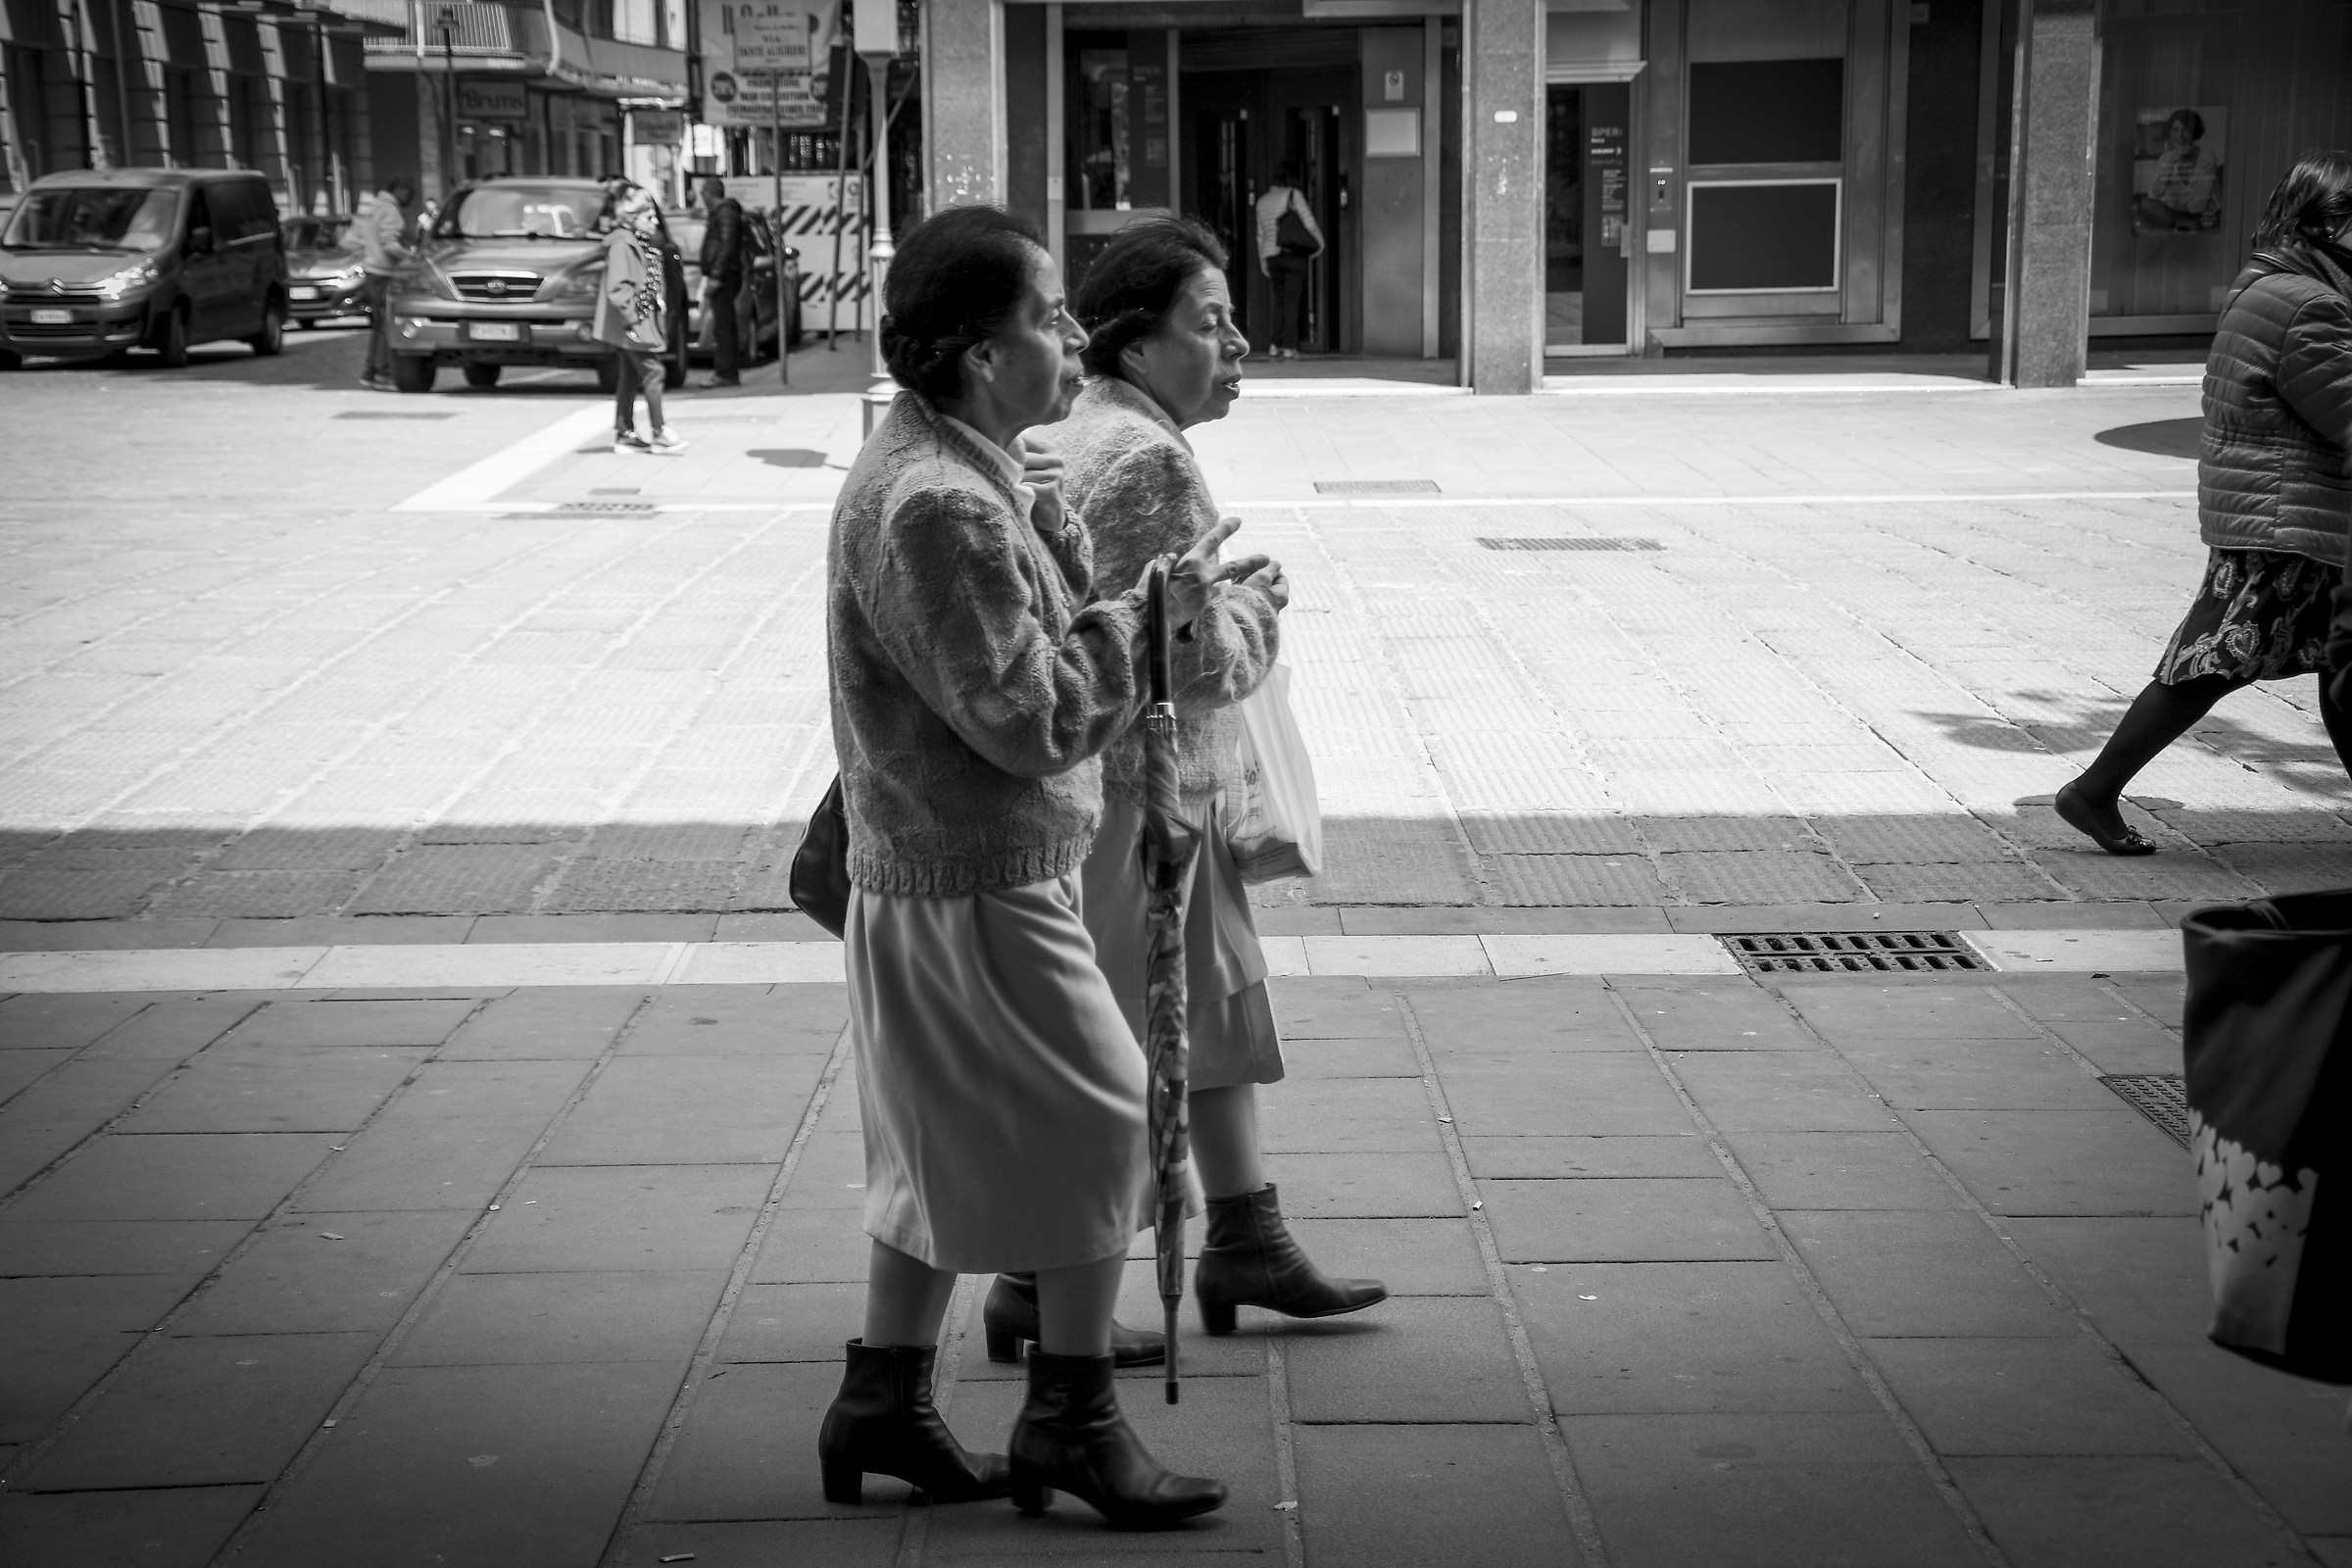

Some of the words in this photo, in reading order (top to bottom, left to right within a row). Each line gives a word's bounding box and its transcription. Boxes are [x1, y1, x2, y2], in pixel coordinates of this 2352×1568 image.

[737, 45, 763, 56] DANTE
[766, 44, 806, 56] ALIGHIERI
[746, 77, 801, 88] PROMZIONE
